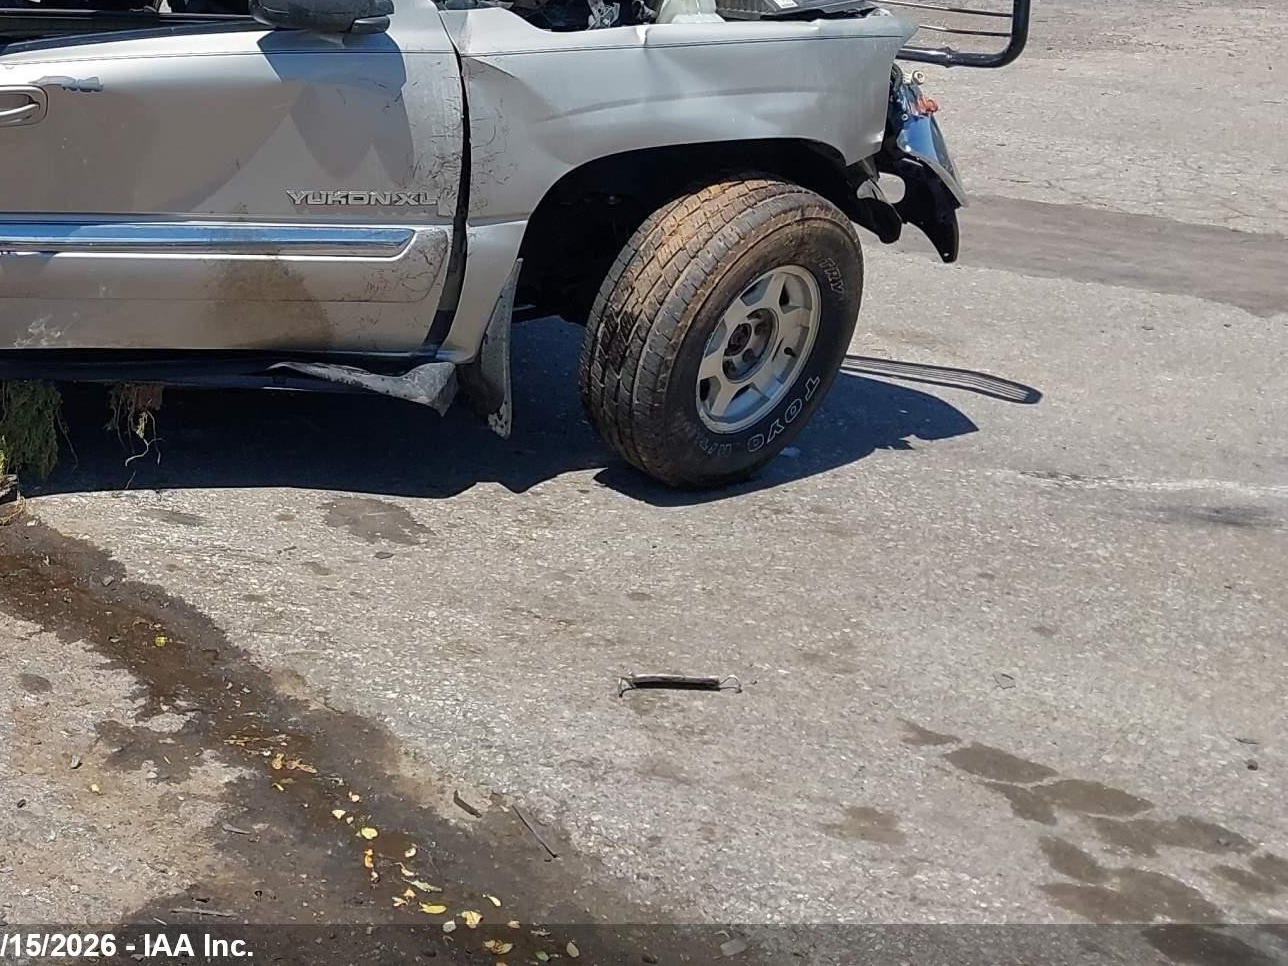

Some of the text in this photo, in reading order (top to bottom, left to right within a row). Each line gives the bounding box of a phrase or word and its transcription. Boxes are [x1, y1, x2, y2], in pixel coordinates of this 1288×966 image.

[286, 189, 438, 206] YUKON XL
[747, 375, 821, 452] TOYO
